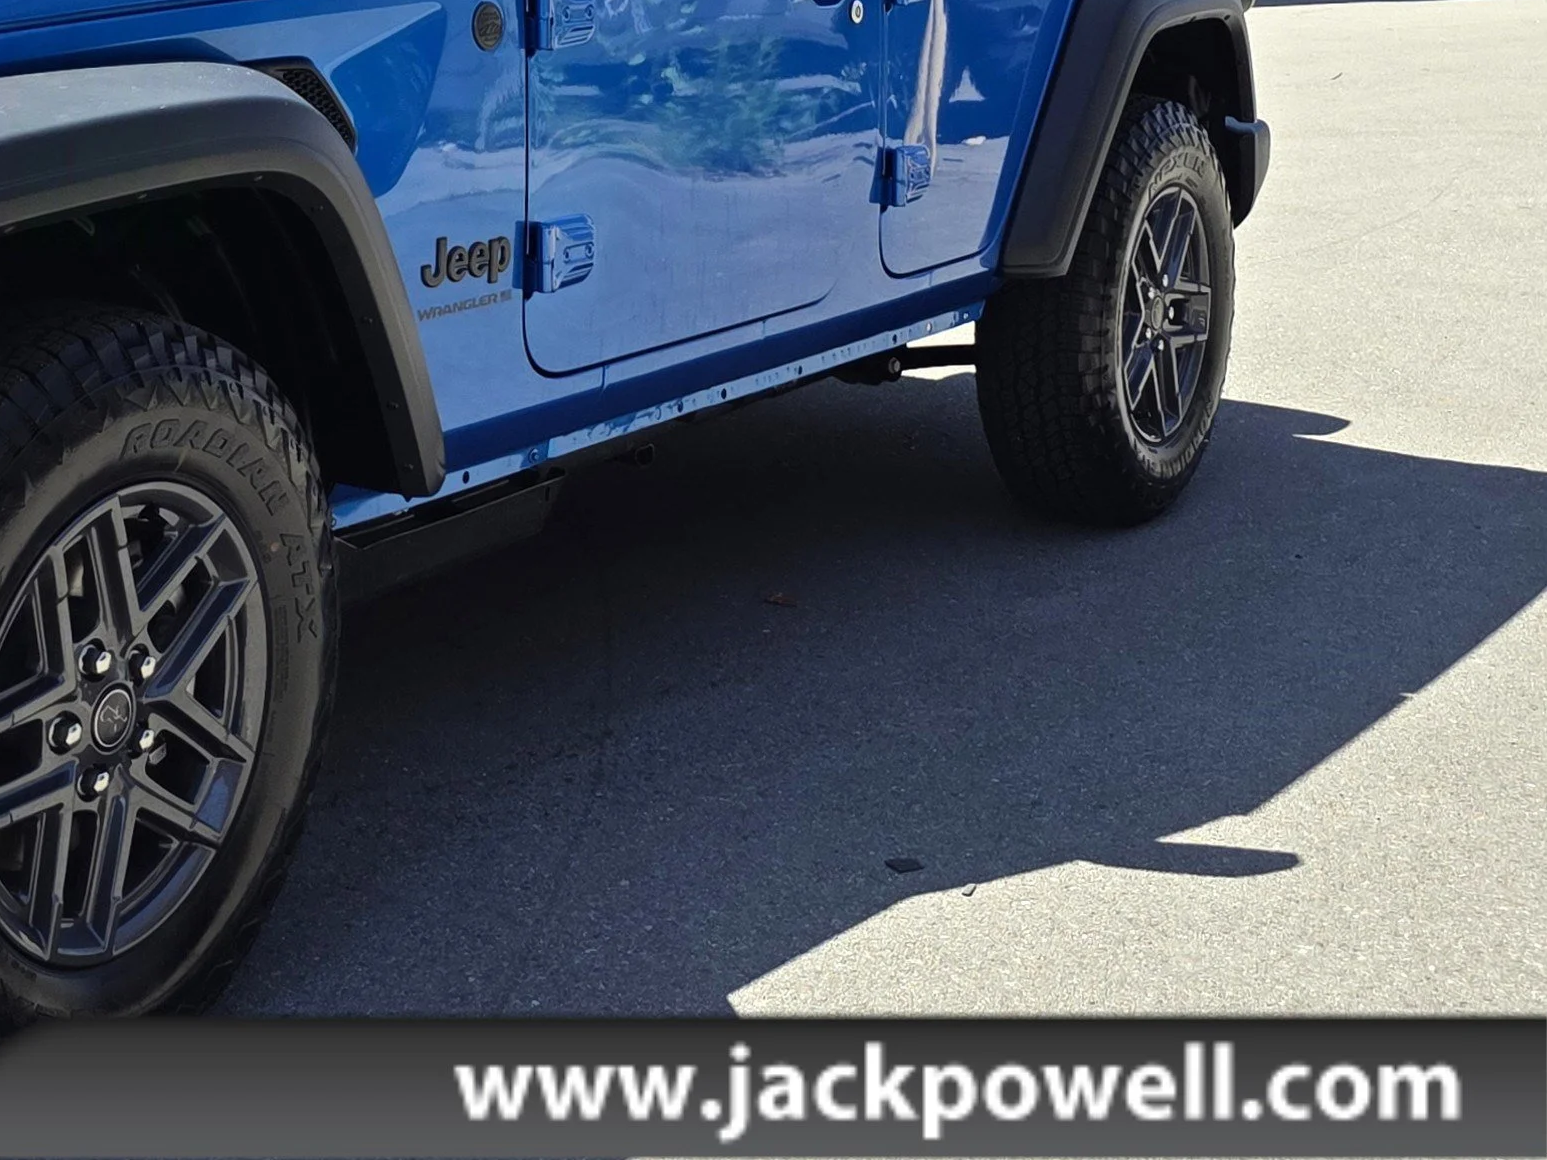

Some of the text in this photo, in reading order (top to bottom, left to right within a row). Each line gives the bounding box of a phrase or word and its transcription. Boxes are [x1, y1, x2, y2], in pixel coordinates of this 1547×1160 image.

[420, 236, 511, 288] Jeep
[417, 293, 499, 321] WRANGLER
[280, 533, 319, 644] ATX
